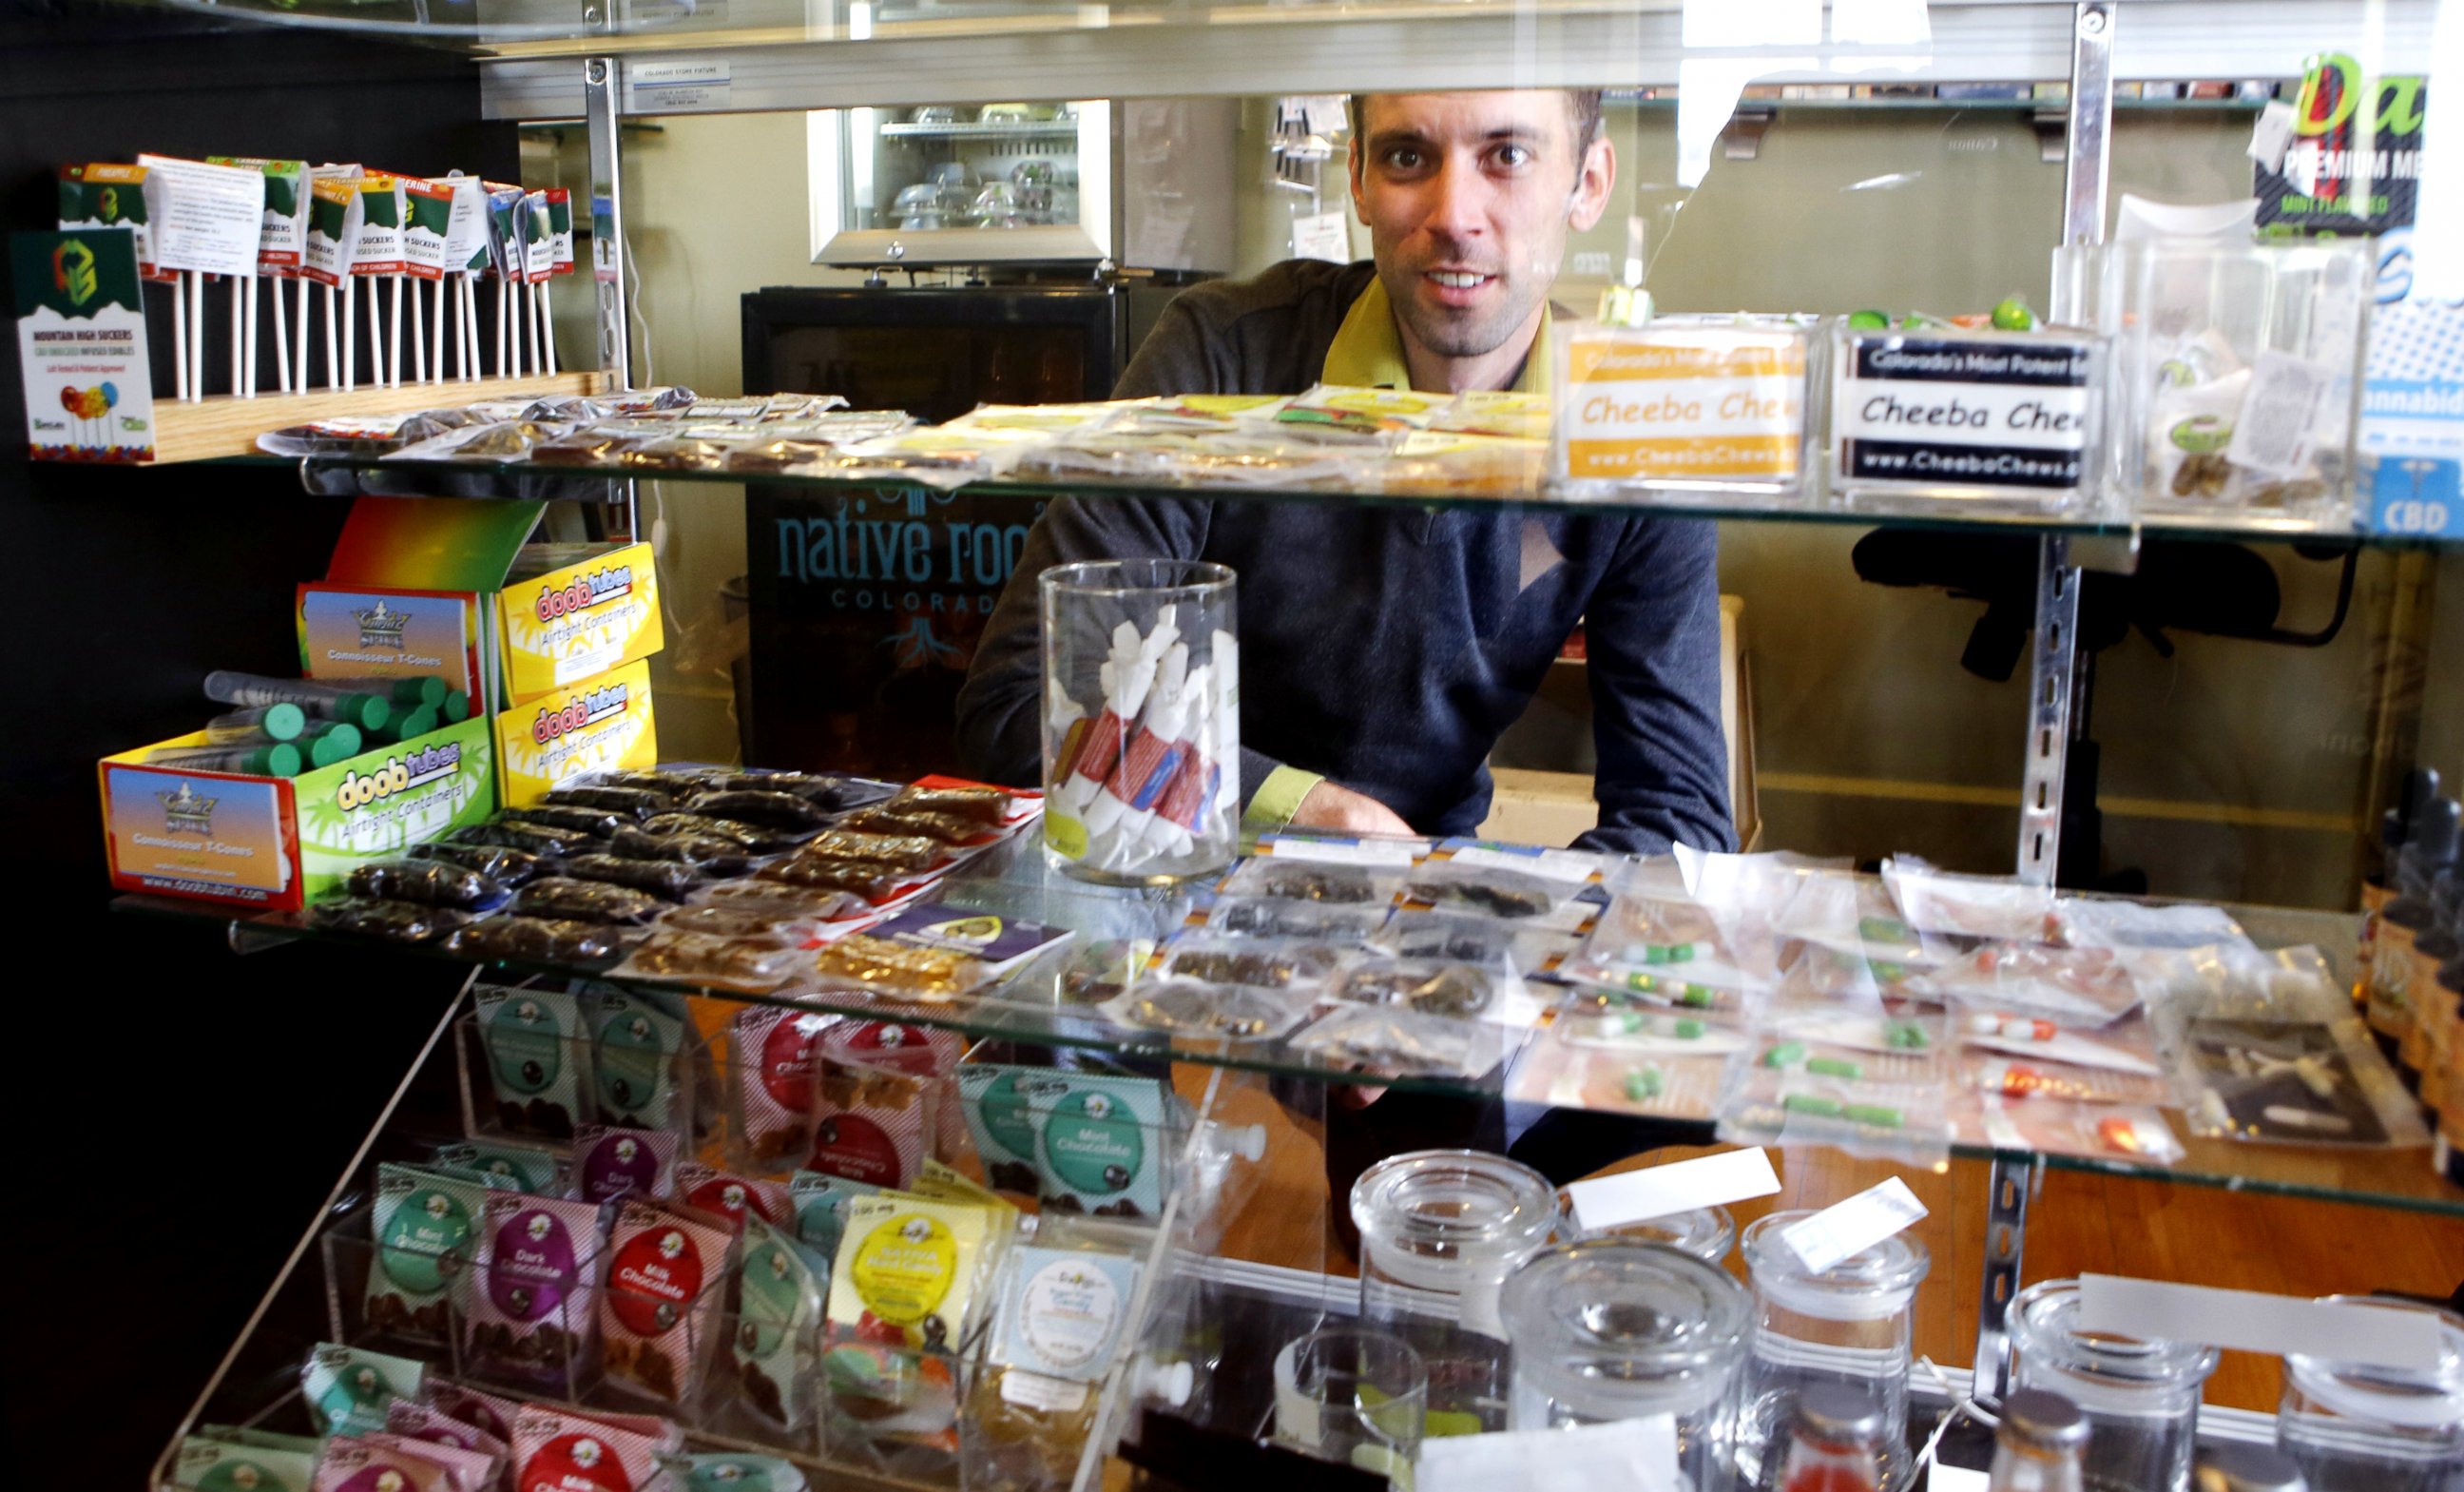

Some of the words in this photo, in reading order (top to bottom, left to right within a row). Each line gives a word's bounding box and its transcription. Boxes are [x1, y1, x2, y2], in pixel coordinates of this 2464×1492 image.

[362, 236, 395, 245] SUCKERS
[411, 237, 441, 251] SUCKERS
[33, 331, 74, 341] MOUNTAIN
[98, 329, 132, 340] SUCKERS
[1869, 348, 1964, 372] Colorado's
[1967, 354, 2007, 373] Most
[2011, 355, 2068, 376] Potent
[1582, 396, 1702, 424] Cheeba
[1862, 396, 1990, 428] Cheeba
[2008, 401, 2084, 431] Che
[2385, 501, 2448, 533] CBD
[776, 496, 932, 583] native
[947, 501, 1046, 587] roo
[832, 588, 994, 614] COLORAD
[541, 621, 583, 647] Airtight
[586, 602, 637, 630] Containers
[327, 649, 395, 665] Connoisseur
[398, 652, 442, 666] T-Cones
[343, 809, 394, 838] Airtight
[397, 785, 462, 819] Containers
[132, 832, 202, 852] Connoisseur
[1079, 1128, 1109, 1141] Mint
[1056, 1137, 1132, 1157] Chocolate
[514, 1249, 546, 1264] Dark
[499, 1257, 563, 1279] Chocolate
[644, 1262, 670, 1279] Milk
[619, 1266, 685, 1300] Chocolate
